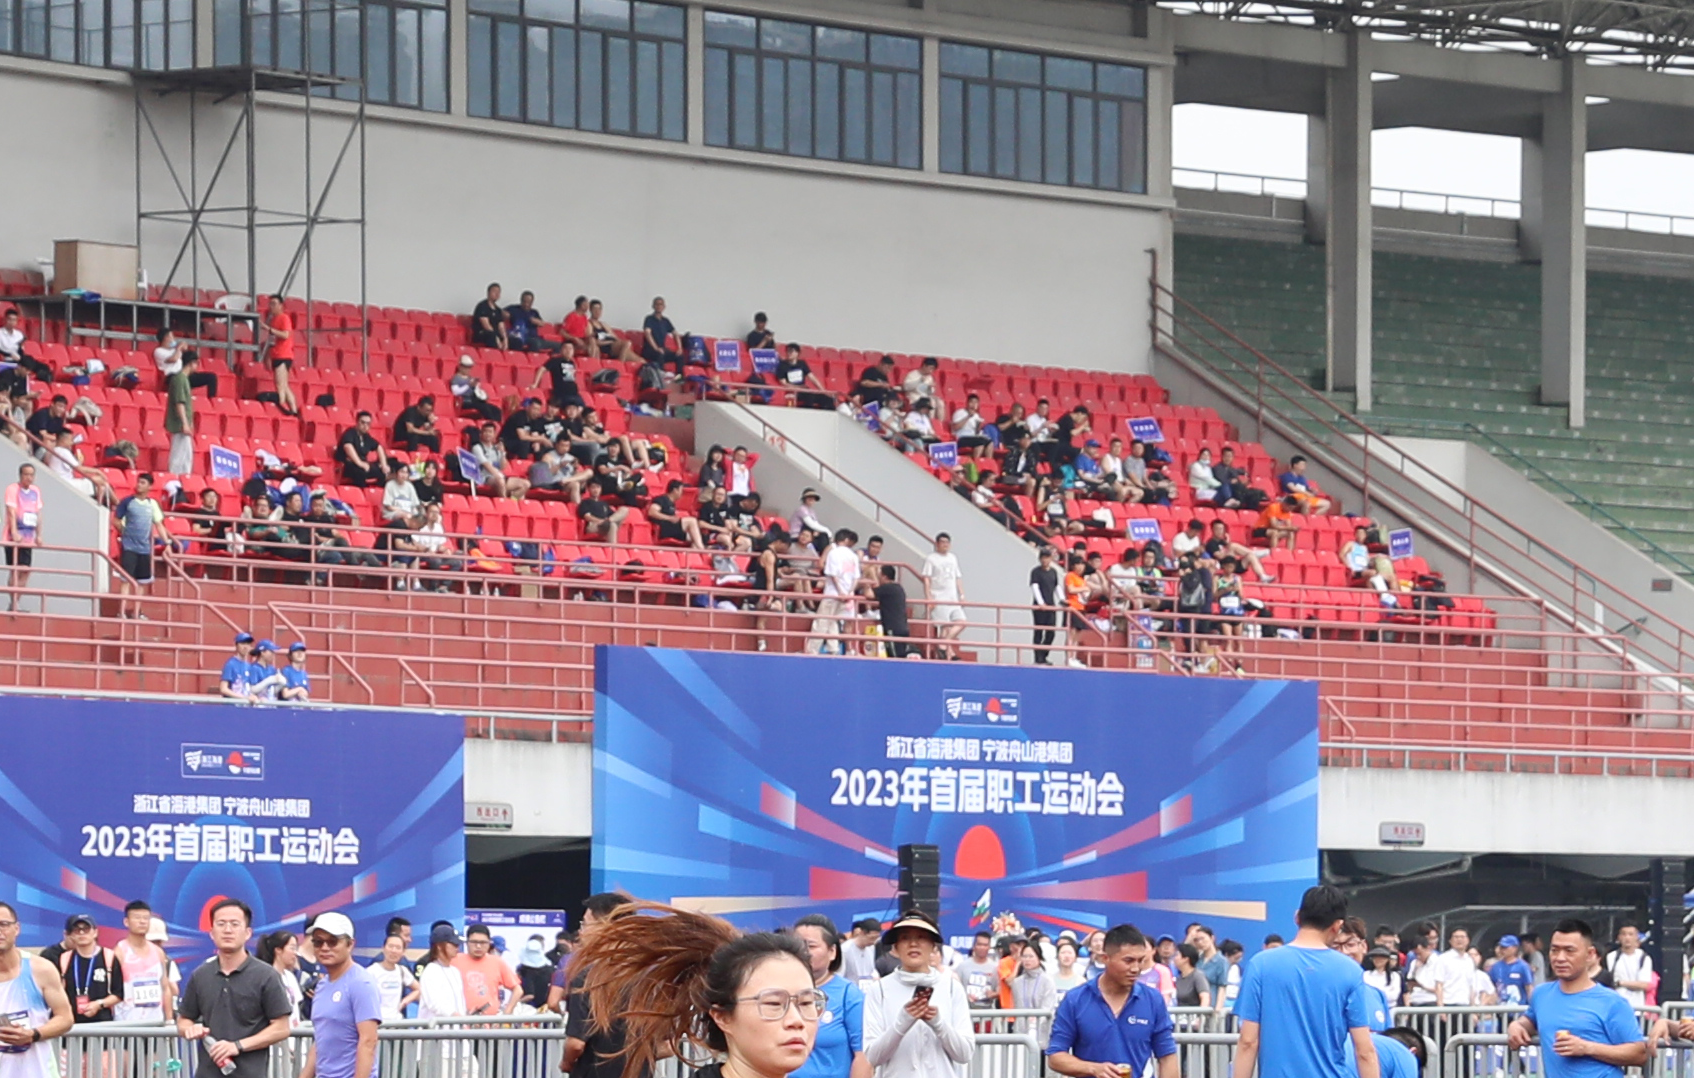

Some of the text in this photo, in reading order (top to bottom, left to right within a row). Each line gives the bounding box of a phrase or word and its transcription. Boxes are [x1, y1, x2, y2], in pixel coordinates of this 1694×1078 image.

[886, 735, 1073, 763] 浙江省海港集团 宁波舟山港集团
[133, 794, 311, 818] 浙江省海港集团 宁波舟山港集团
[830, 766, 1125, 816] 2023年首届职工运动会
[81, 823, 359, 865] 2023年首届职工运动会
